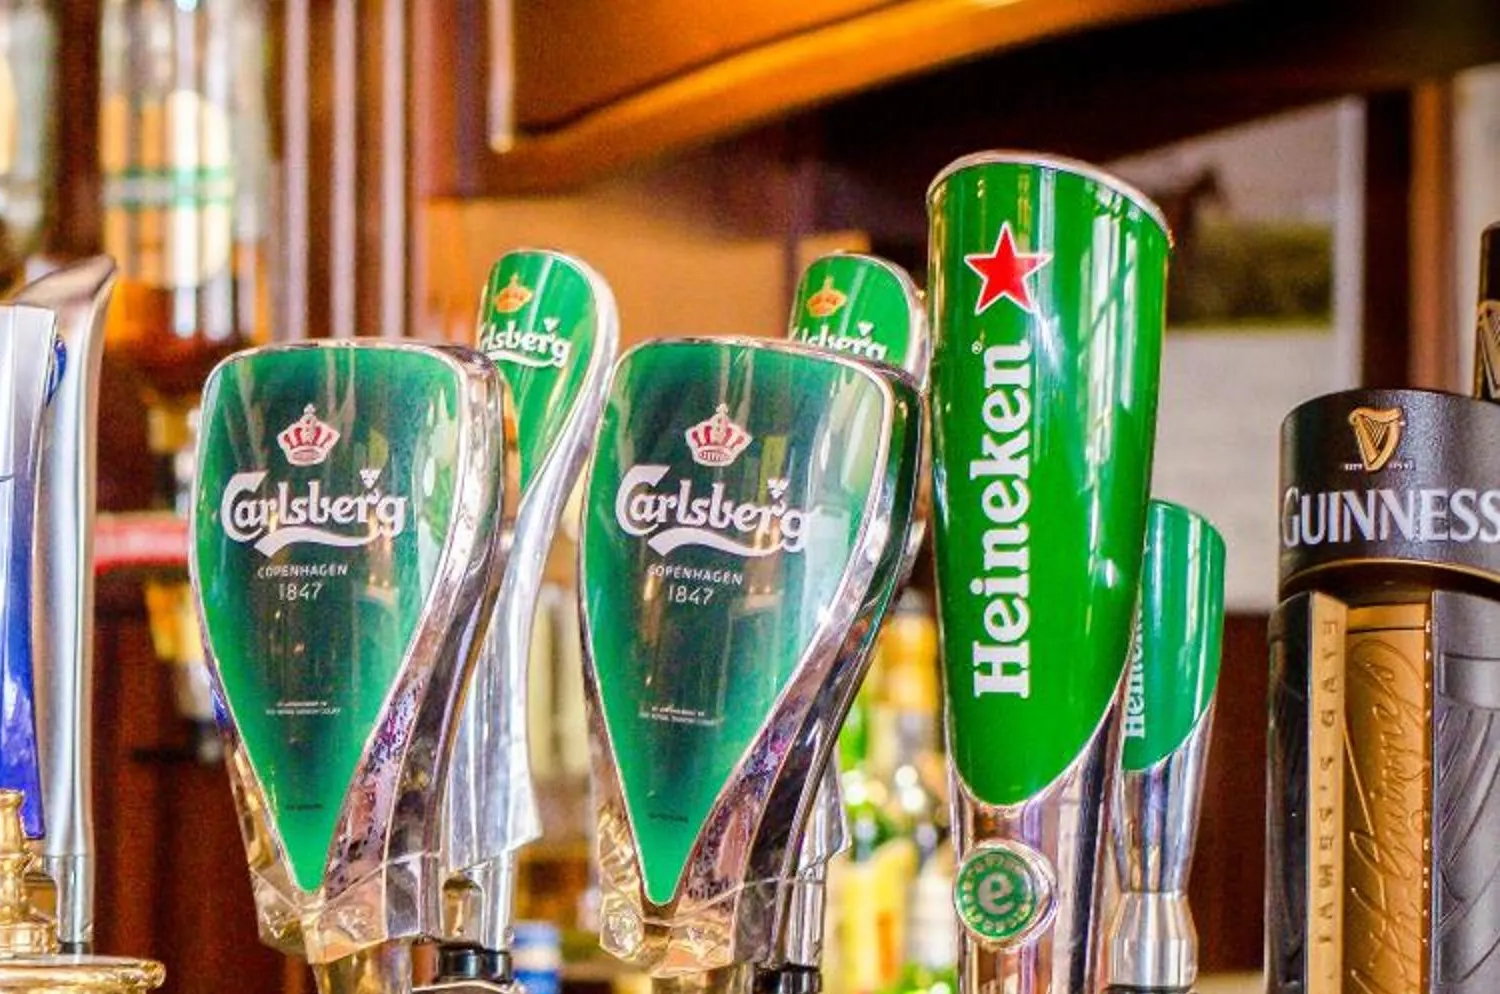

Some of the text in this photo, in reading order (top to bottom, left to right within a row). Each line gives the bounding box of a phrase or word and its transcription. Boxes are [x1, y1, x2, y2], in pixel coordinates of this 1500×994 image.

[221, 469, 409, 552] Carlsberg
[615, 464, 821, 553] Carlsberg
[970, 339, 1031, 699] Heineken
[1282, 486, 1500, 547] GUINNESS
[257, 563, 349, 580] COPENHAGEN
[278, 582, 323, 601] 1847
[648, 564, 744, 585] COPENHAGEN
[669, 586, 714, 606] 1847
